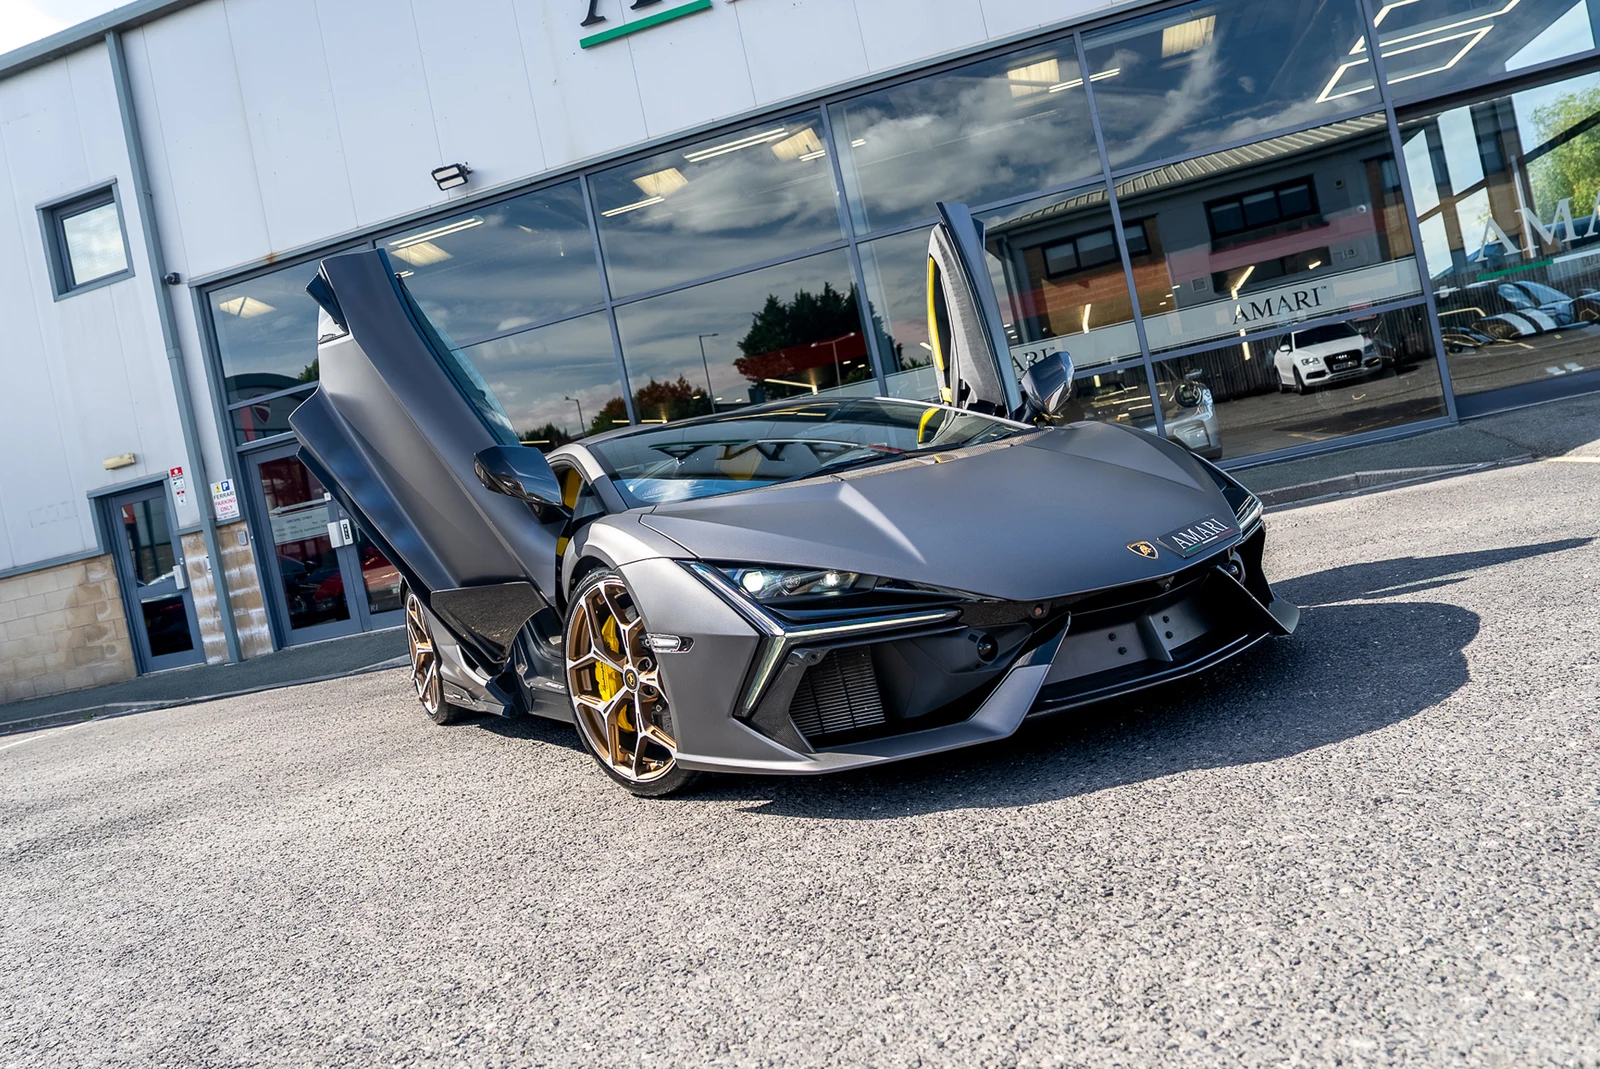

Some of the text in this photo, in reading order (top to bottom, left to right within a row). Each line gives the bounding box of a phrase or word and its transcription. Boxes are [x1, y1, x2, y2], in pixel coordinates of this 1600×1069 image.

[213, 491, 235, 500] FERRARI
[214, 497, 237, 506] PARKING
[1171, 518, 1230, 549] AMARI
